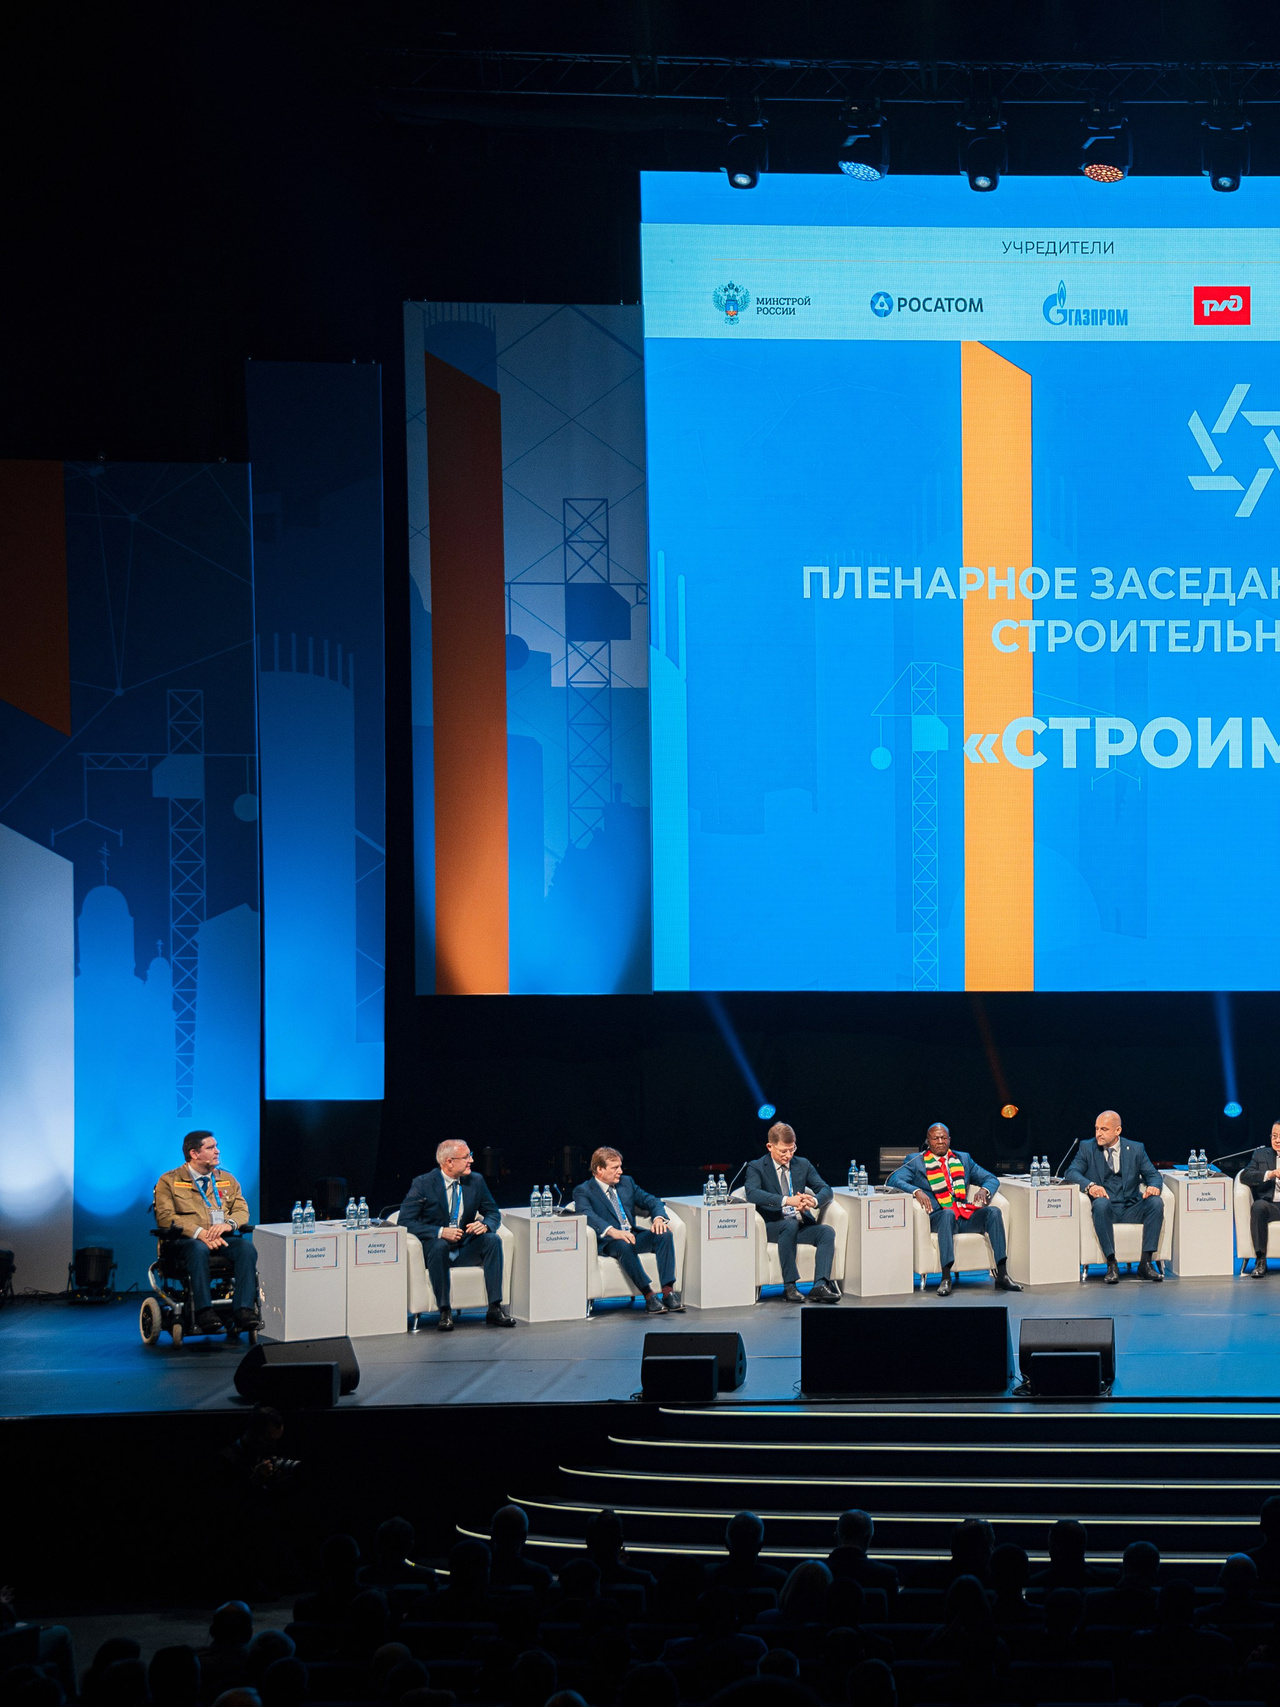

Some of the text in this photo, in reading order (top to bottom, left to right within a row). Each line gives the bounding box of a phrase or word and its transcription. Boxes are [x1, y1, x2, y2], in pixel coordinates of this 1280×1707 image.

[1002, 241, 1114, 256] УЧРЕДИТЕЛИ
[756, 297, 811, 305] МИНСТРОЙ
[897, 297, 984, 312] РОСАТОМ
[756, 307, 796, 316] РОССИИ
[803, 566, 1078, 600] ПЛЕНАРНОЕ
